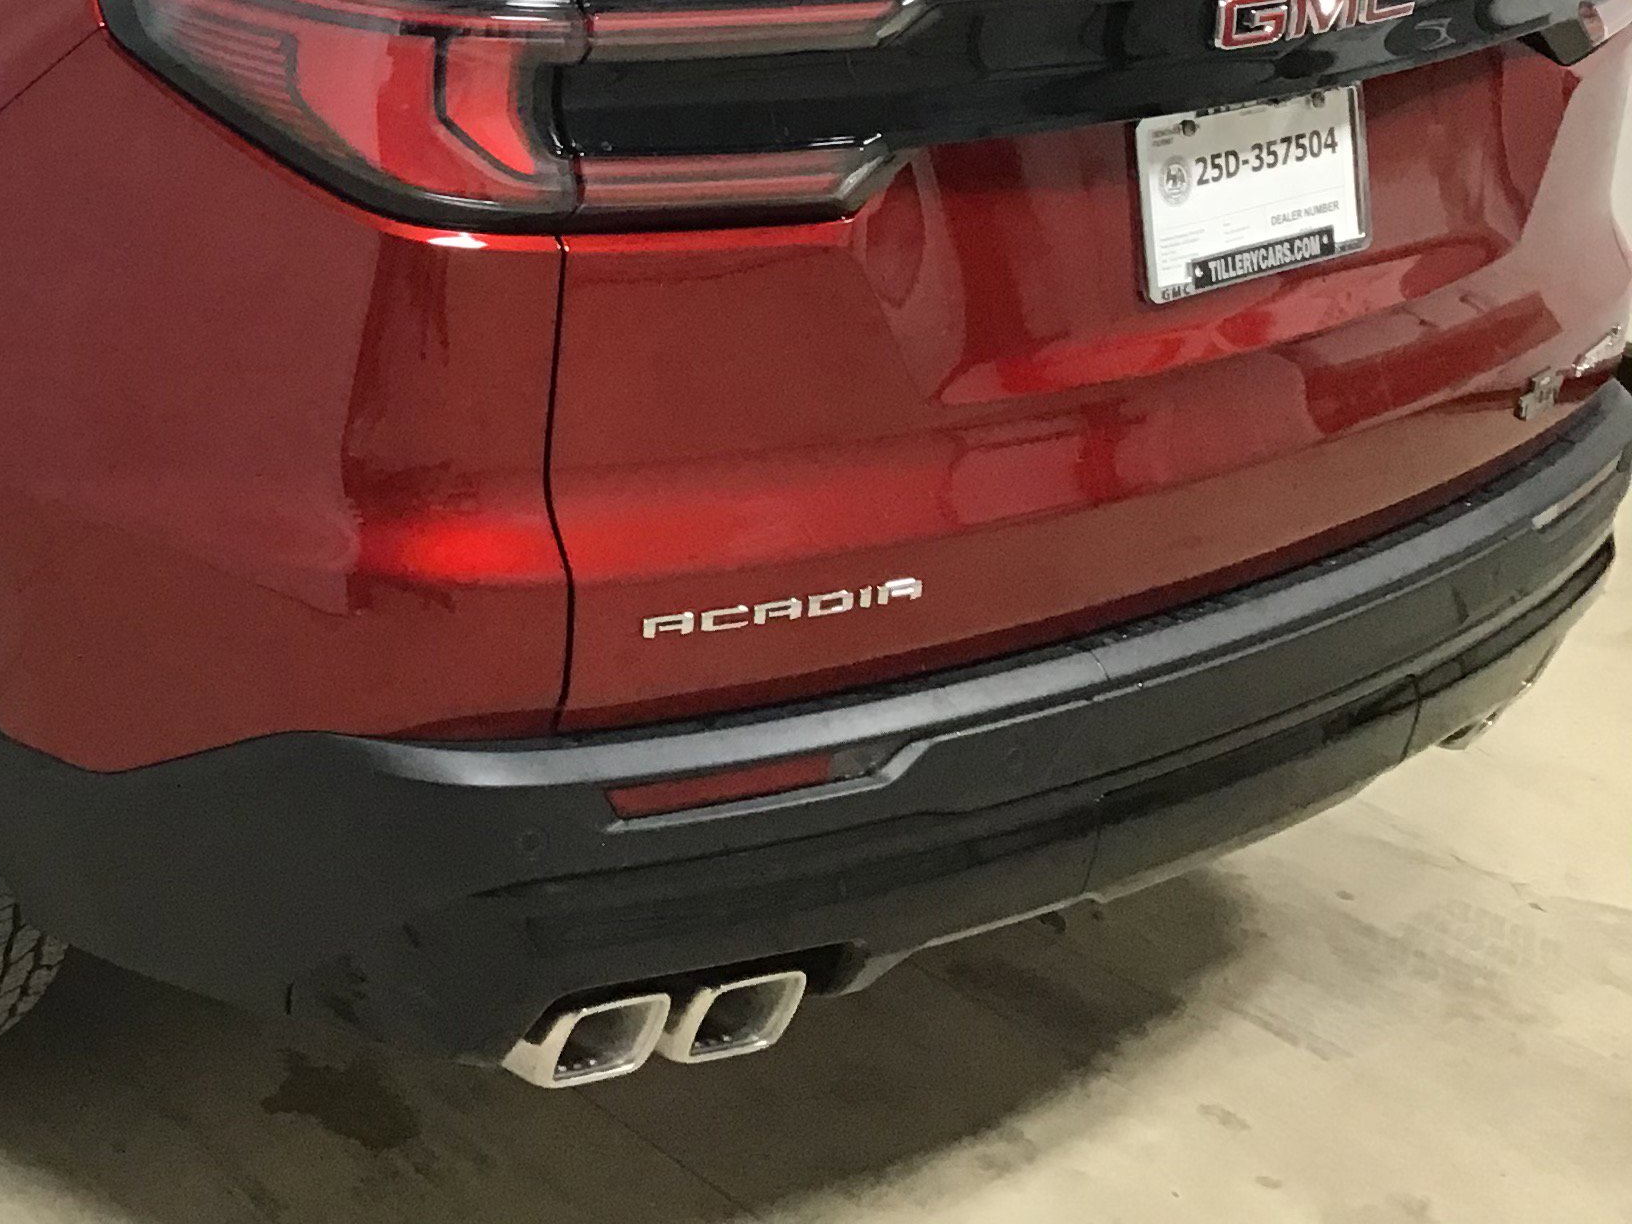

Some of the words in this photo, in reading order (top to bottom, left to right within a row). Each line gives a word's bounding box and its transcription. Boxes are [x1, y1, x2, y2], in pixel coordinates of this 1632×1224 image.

[1194, 126, 1339, 187] 25D-357504
[1270, 208, 1303, 226] DEALER
[1303, 200, 1340, 218] NUMBER
[1207, 235, 1321, 282] TILLERYCARS.COM
[642, 577, 923, 639] ACADIA
